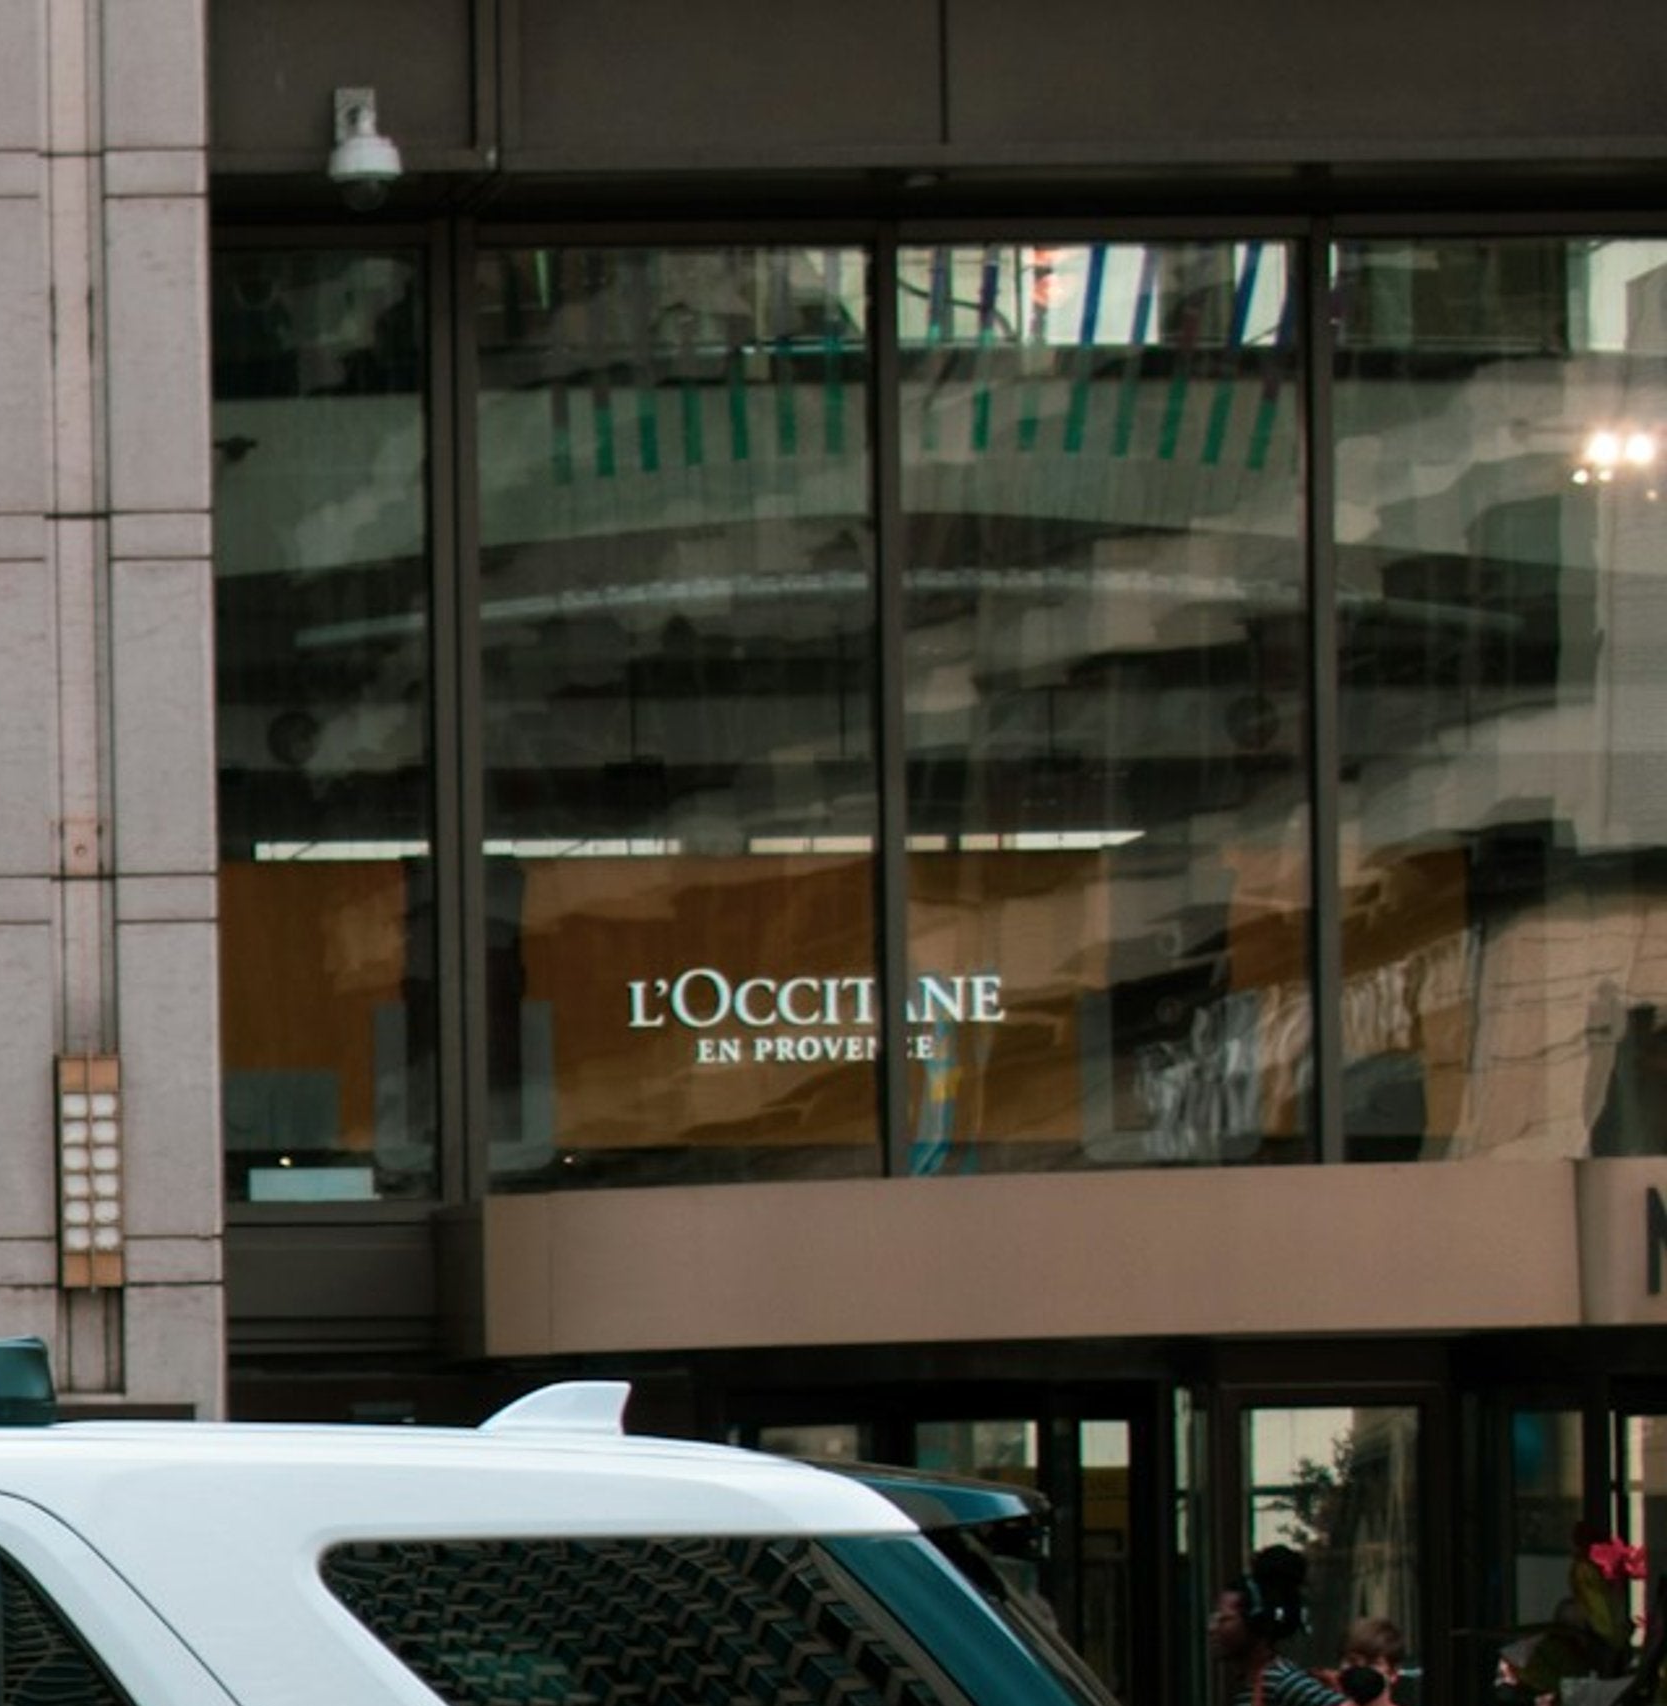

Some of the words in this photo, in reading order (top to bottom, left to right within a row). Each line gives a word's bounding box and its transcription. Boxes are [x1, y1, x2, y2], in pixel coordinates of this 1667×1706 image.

[628, 968, 1007, 1028] L'OCCITNE
[696, 1037, 742, 1064] EN
[753, 1035, 935, 1062] PROVENE
